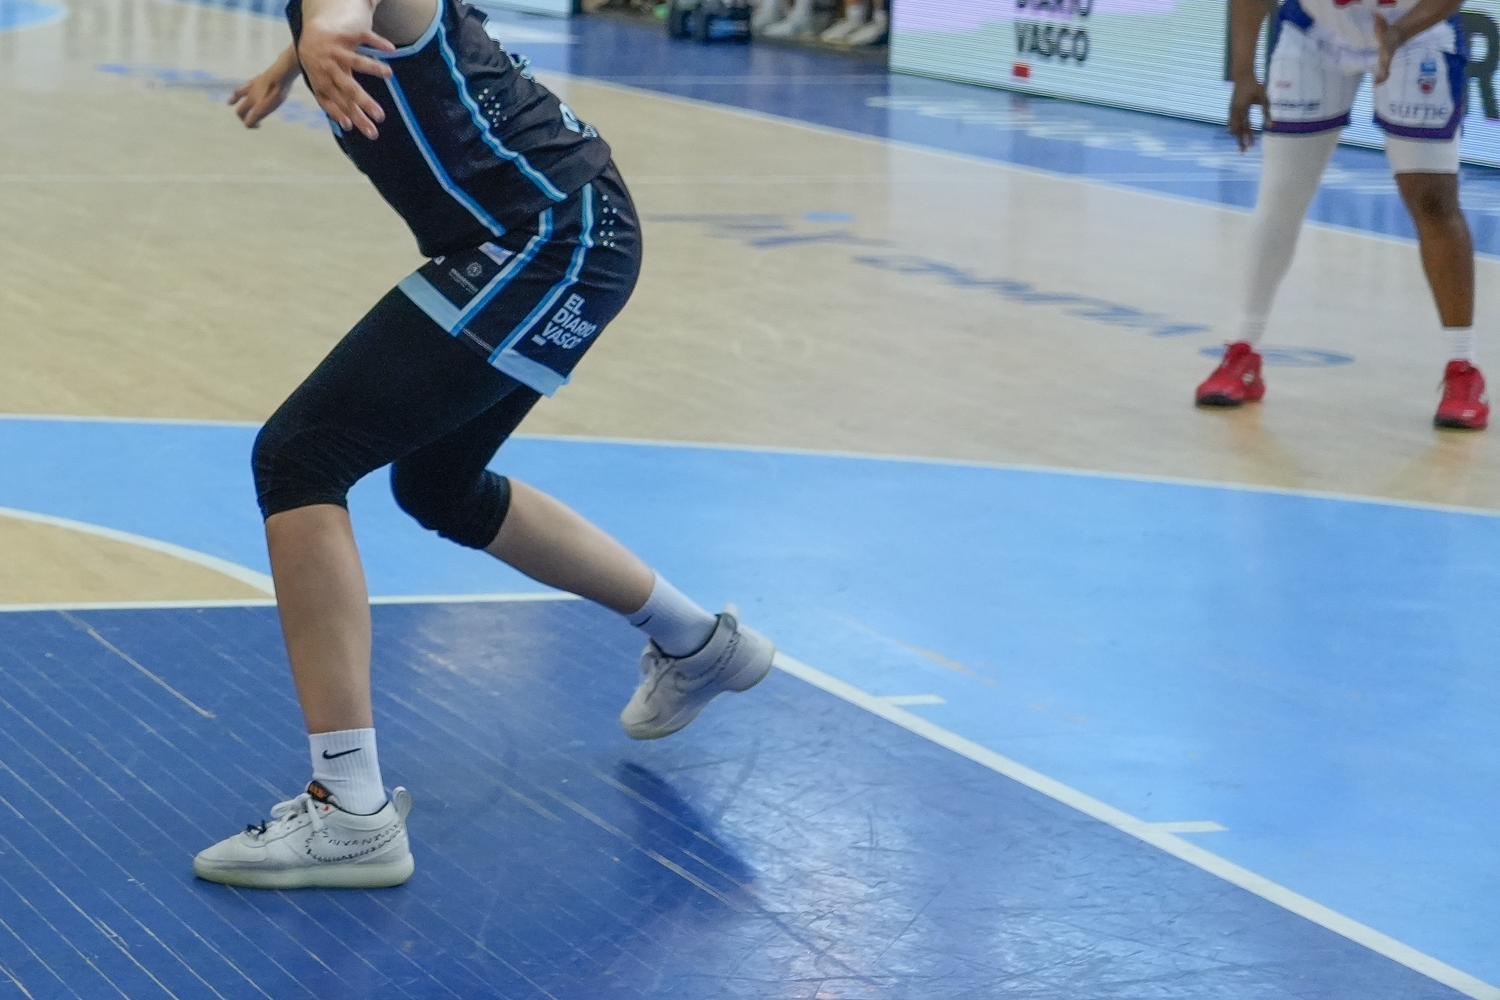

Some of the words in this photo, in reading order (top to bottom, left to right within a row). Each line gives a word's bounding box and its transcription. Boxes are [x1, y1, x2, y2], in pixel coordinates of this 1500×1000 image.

[1015, 22, 1090, 61] VASCO
[563, 293, 586, 316] EL
[541, 322, 583, 350] VASCO
[552, 307, 598, 339] DIARIO
